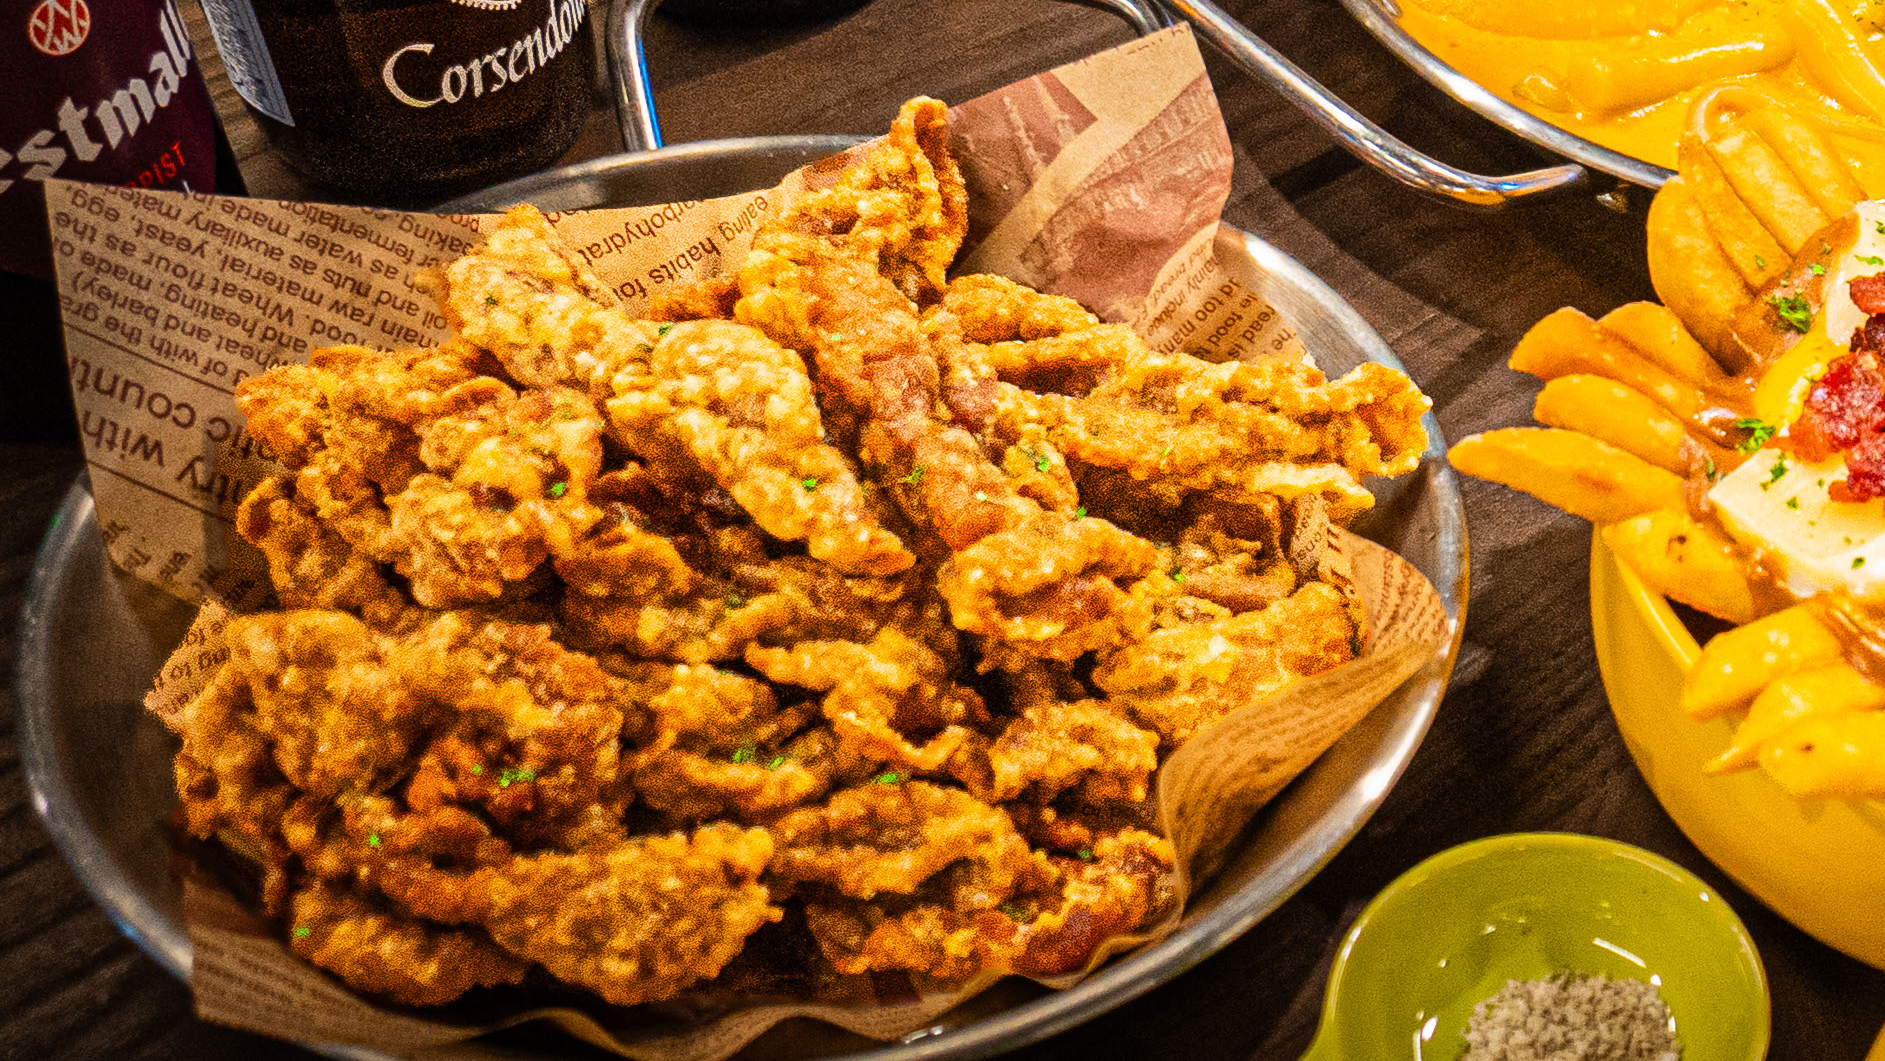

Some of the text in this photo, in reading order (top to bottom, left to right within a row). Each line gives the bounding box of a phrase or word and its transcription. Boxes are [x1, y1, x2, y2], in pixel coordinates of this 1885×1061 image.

[124, 140, 185, 188] PIST
[65, 184, 121, 223] egg,
[220, 198, 291, 238] made
[717, 194, 769, 243] eating
[55, 210, 98, 245] the
[104, 232, 138, 258] as
[130, 214, 210, 260] yeast,
[184, 210, 285, 262] auxiliary
[576, 199, 698, 269] arbohydrat
[288, 253, 318, 276] as
[293, 230, 364, 269] water
[369, 258, 400, 281] as
[648, 236, 723, 286] habits
[80, 250, 154, 292] made
[141, 251, 207, 291] flour
[216, 248, 325, 308] material,
[322, 267, 373, 299] nuts
[71, 270, 161, 327] barley)
[210, 276, 295, 328] Wheat
[328, 298, 376, 328] raw
[373, 289, 421, 318] and
[422, 304, 448, 331] oil
[1194, 295, 1225, 323] too
[61, 293, 229, 377] of with the gra
[162, 312, 212, 344] and
[261, 324, 309, 355] and
[81, 410, 165, 467] with
